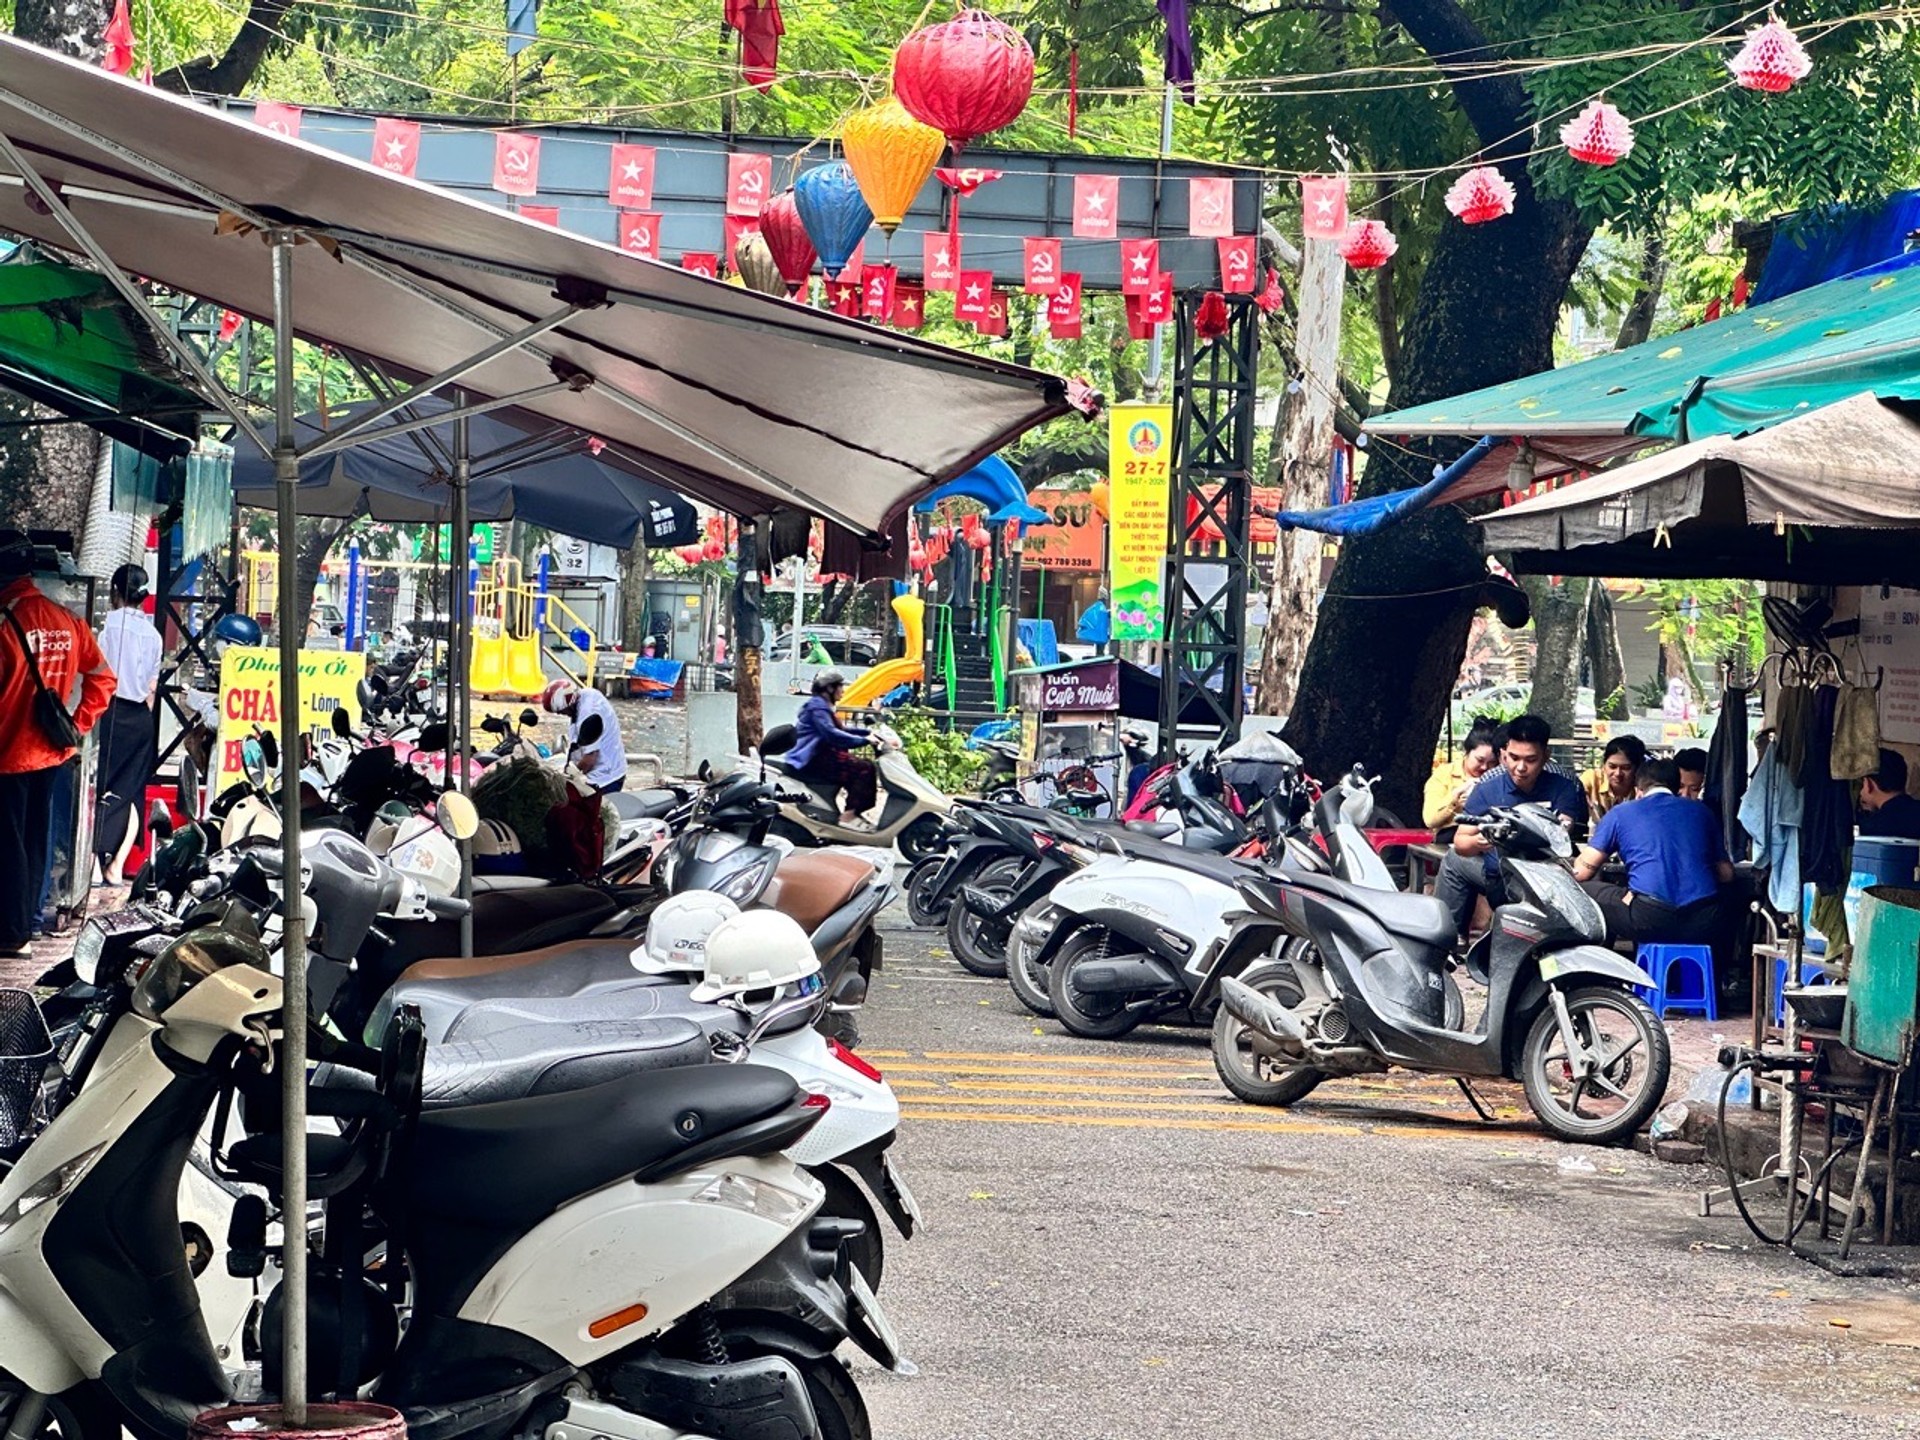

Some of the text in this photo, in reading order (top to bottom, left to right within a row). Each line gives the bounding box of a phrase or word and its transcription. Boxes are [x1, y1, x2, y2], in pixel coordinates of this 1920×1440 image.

[1125, 461, 1166, 475] 27-7
[567, 558, 583, 569] 32
[40, 637, 72, 652] Food
[1046, 671, 1080, 685] Tuấn
[1046, 686, 1075, 708] Cafe
